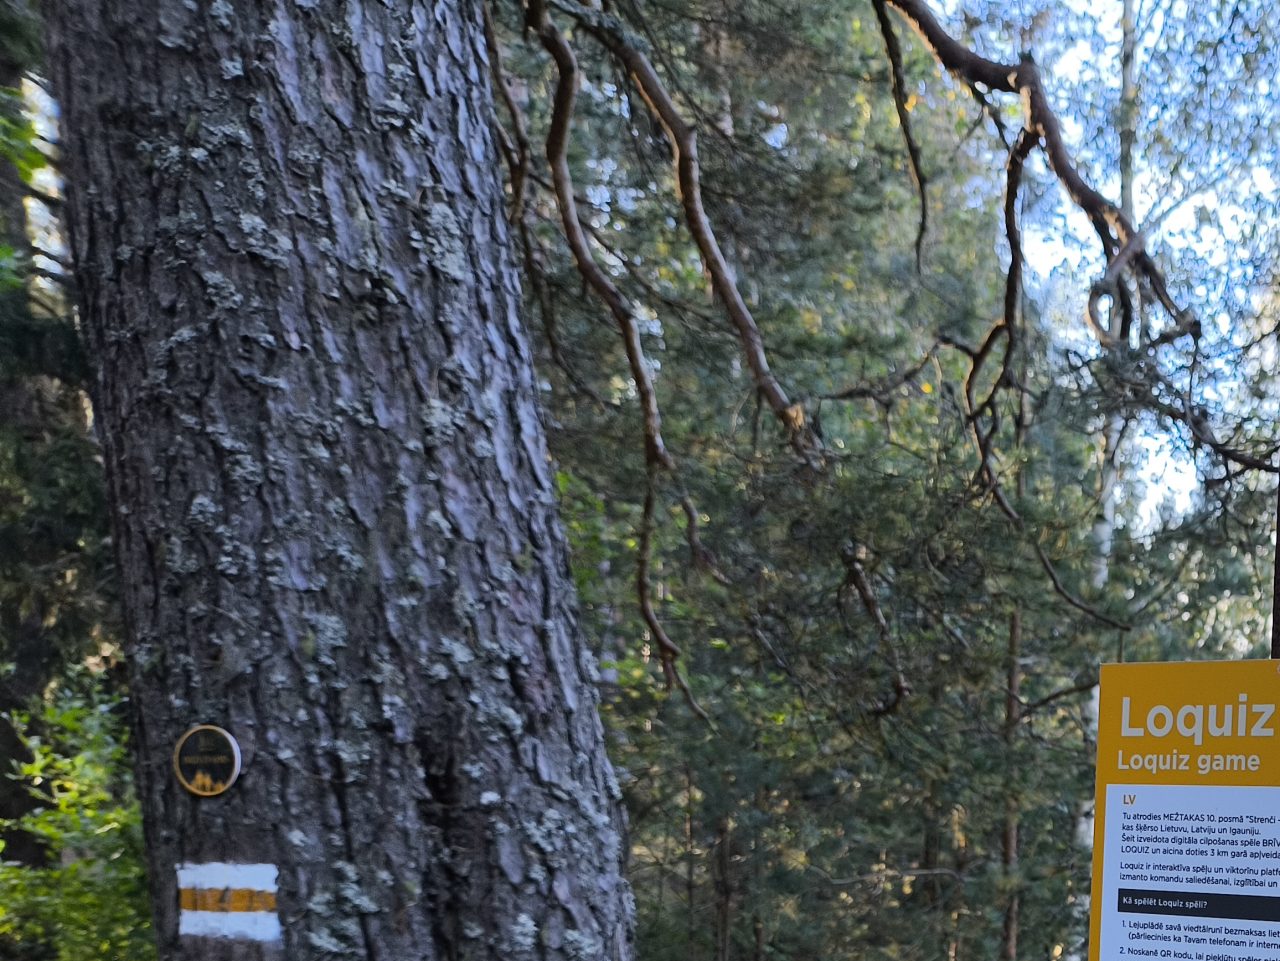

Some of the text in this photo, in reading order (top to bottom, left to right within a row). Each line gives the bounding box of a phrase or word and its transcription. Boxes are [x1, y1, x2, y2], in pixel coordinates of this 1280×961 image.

[1120, 692, 1276, 746] Loquiz
[1117, 748, 1261, 775] Loquiz game
[1123, 794, 1137, 805] LV
[1122, 811, 1132, 821] Tu
[1132, 812, 1162, 821] atrodies
[1162, 811, 1206, 823] MEŽTAKAS
[1206, 813, 1217, 823] 10.
[1217, 815, 1244, 824] posmā
